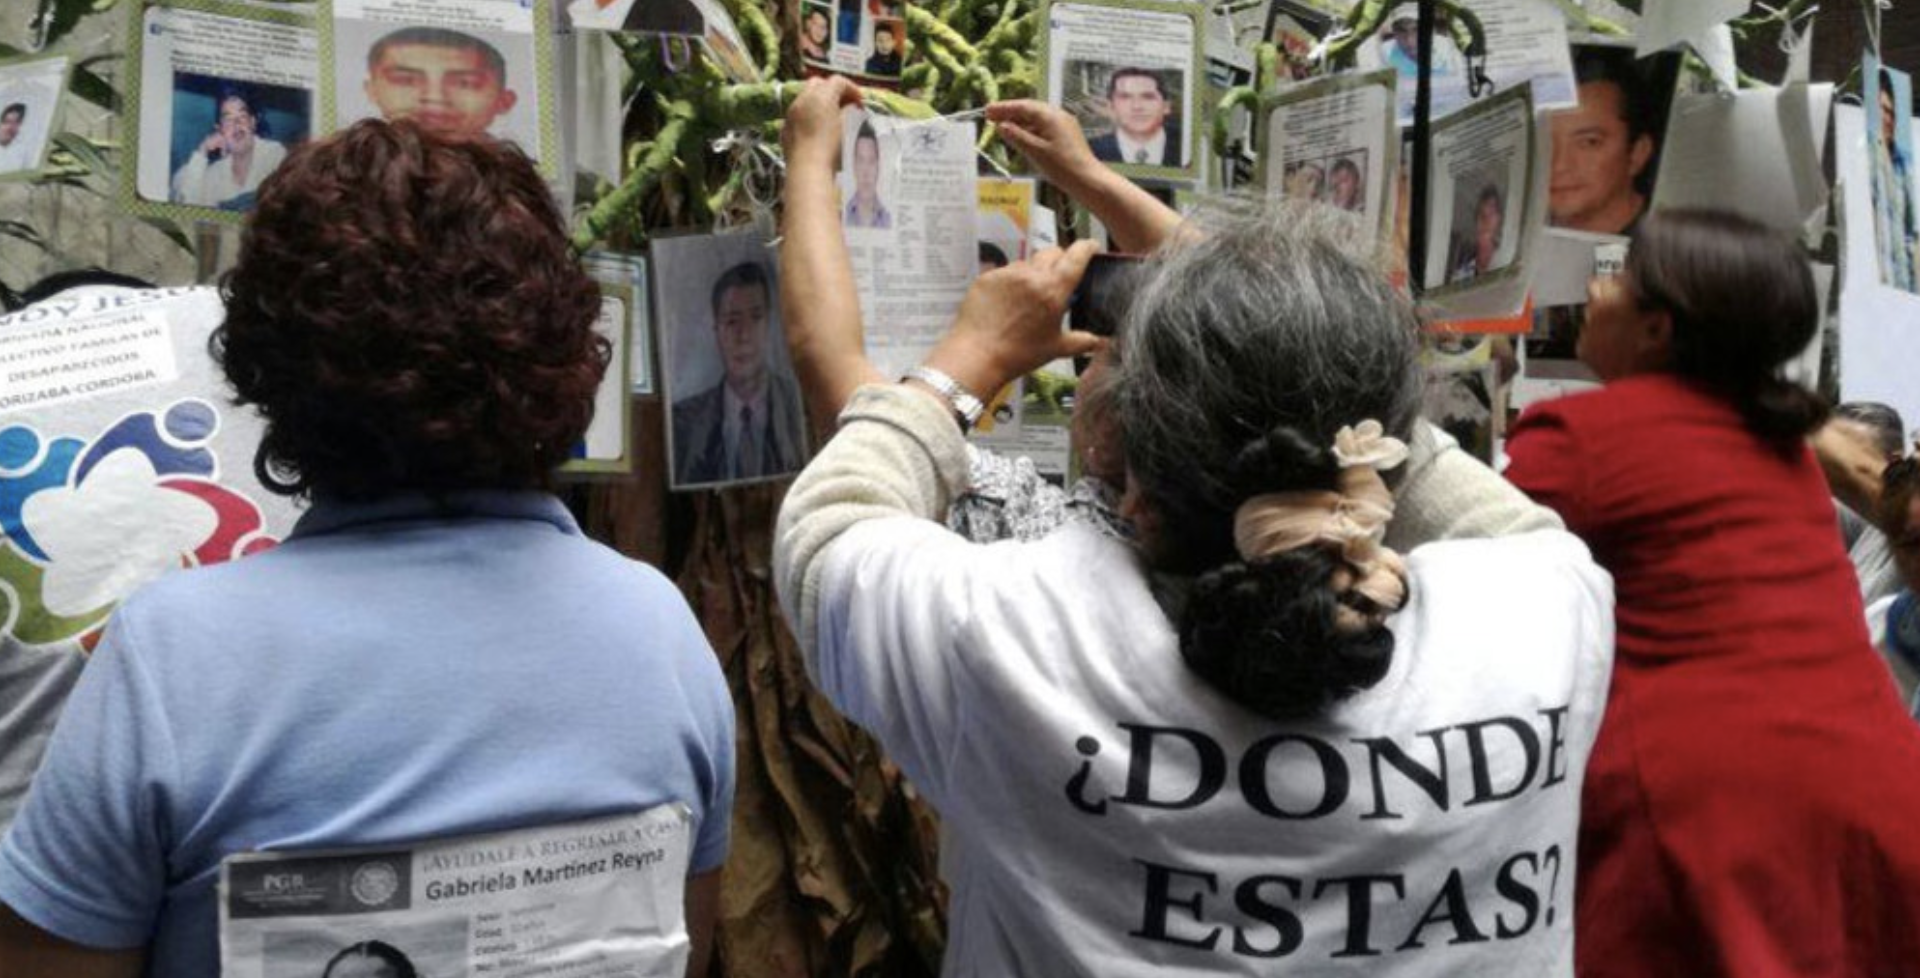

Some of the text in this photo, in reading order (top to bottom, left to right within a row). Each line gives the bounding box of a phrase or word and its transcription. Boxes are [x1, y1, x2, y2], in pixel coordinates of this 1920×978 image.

[1064, 704, 1570, 821] ¿DONDE
[426, 872, 517, 901] Gabriela
[611, 848, 665, 872] Reyna
[1128, 844, 1560, 959] ESTAS?
